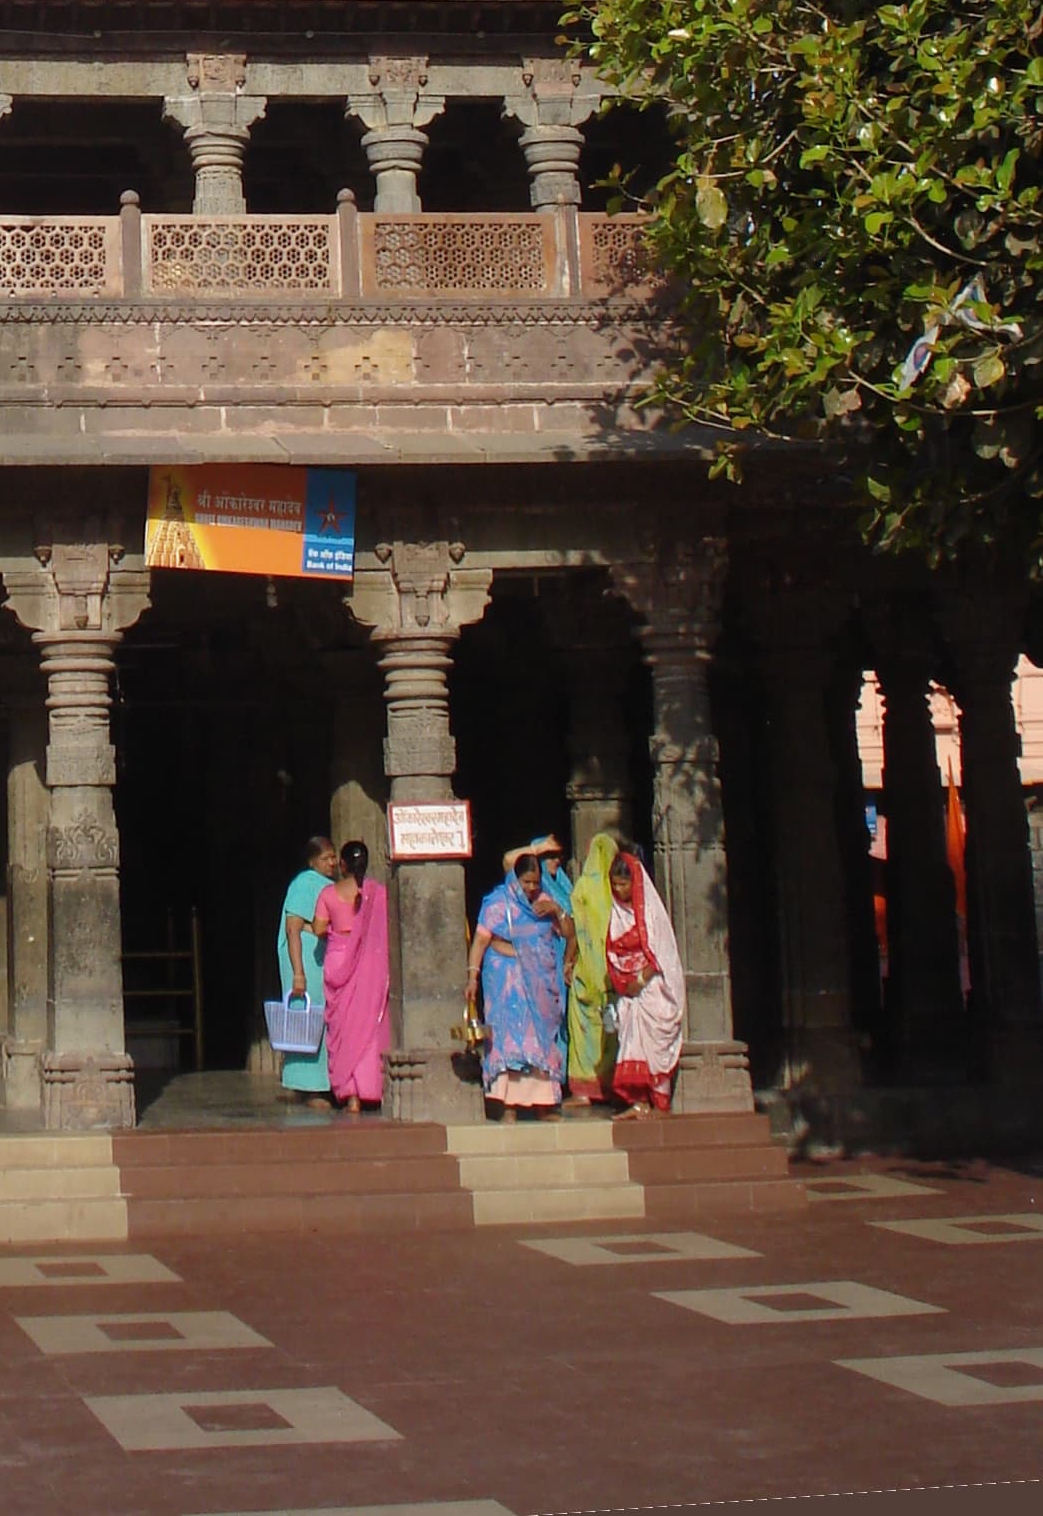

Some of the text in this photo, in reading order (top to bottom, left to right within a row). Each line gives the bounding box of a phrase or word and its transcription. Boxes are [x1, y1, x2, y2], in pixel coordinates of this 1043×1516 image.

[306, 560, 353, 572] Bank of India
